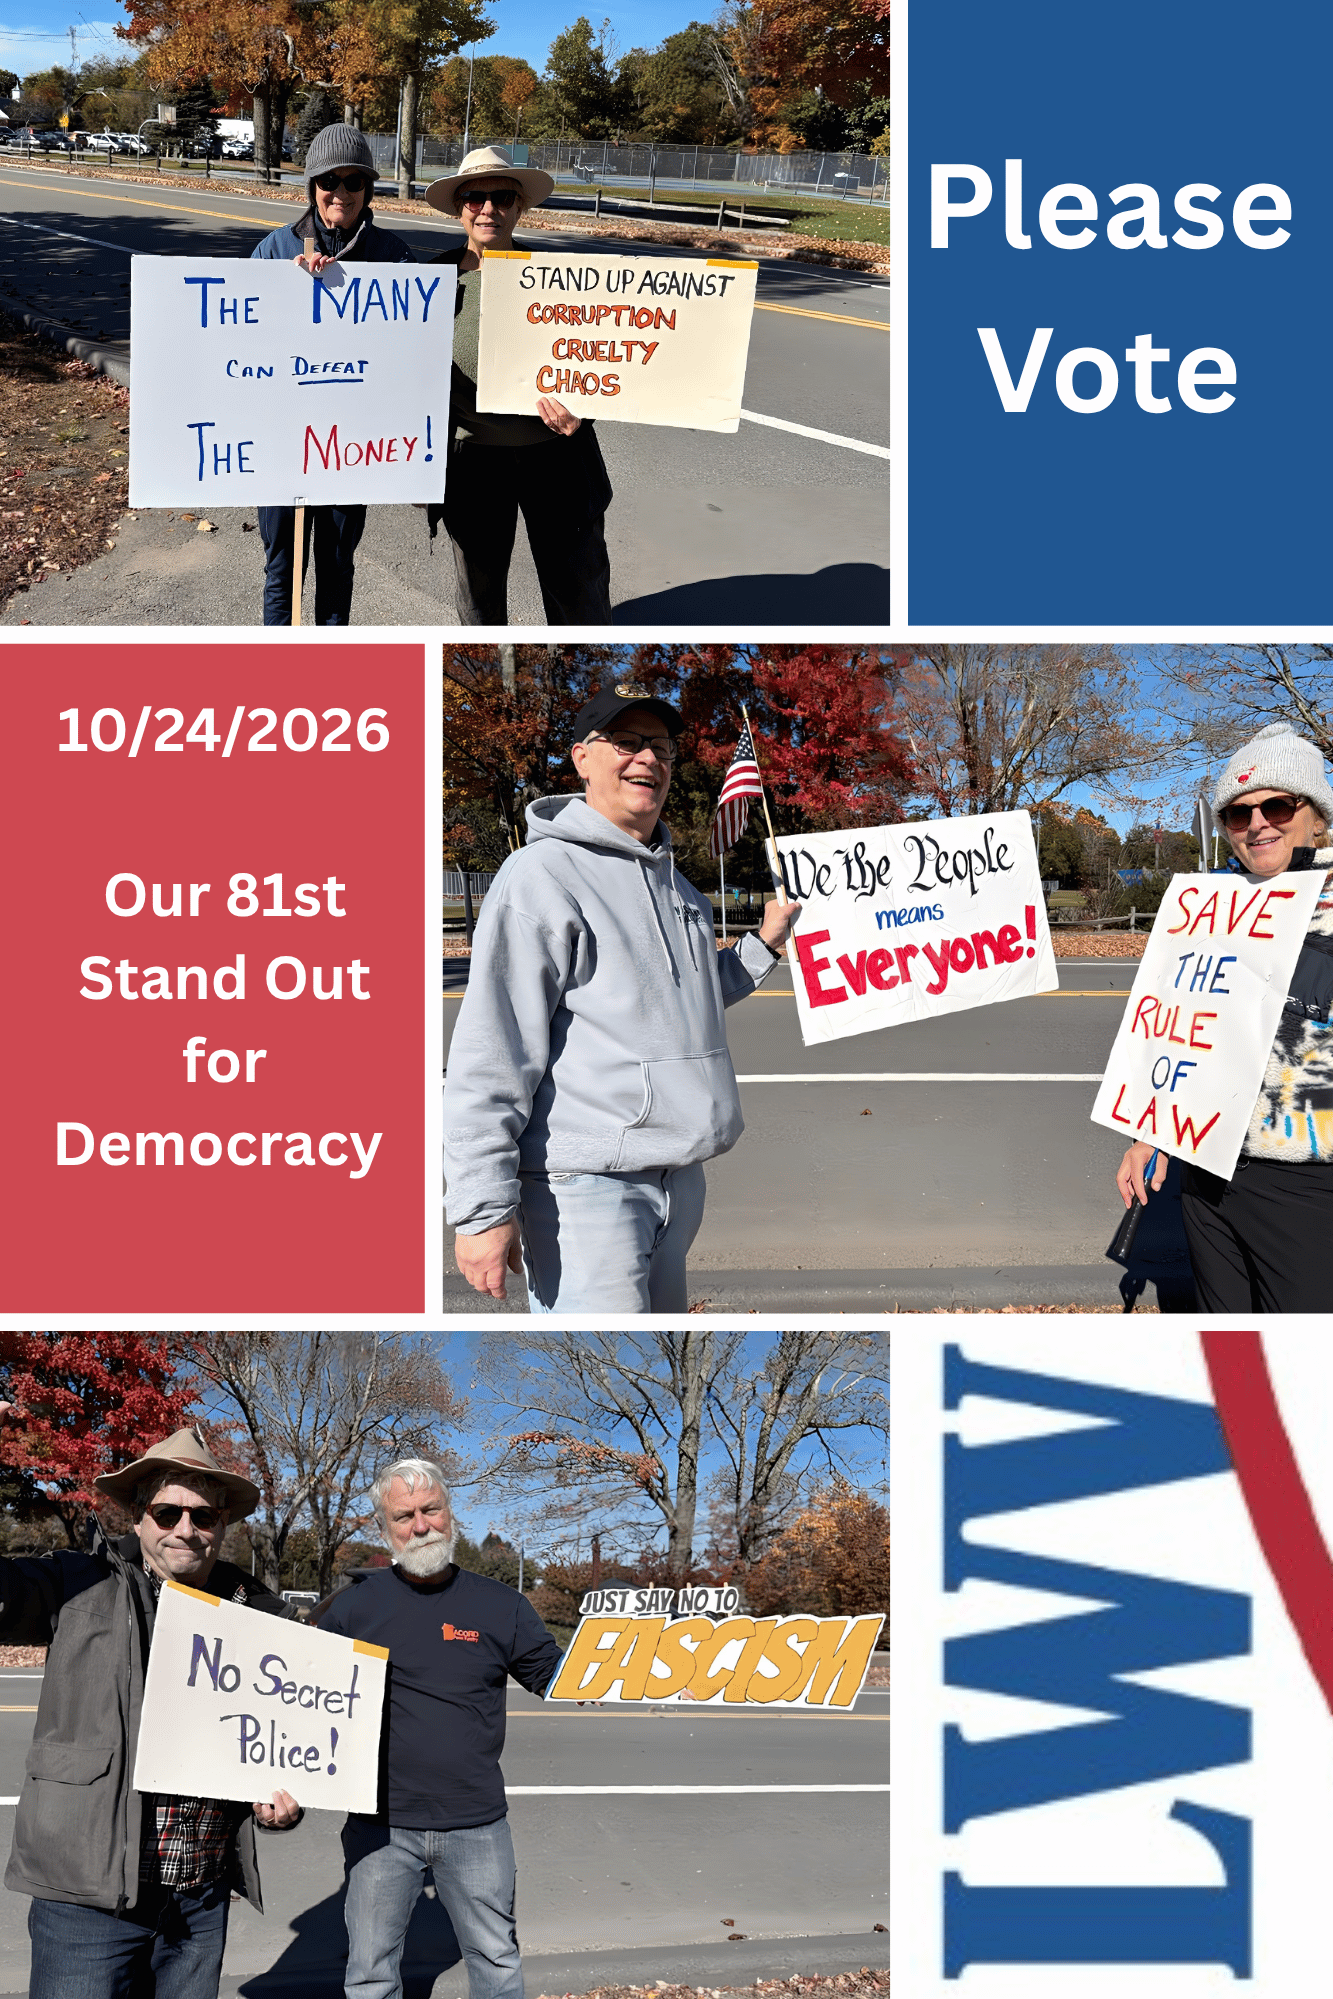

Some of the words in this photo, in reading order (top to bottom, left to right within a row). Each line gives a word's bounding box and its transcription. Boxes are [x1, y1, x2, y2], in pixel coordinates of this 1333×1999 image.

[184, 277, 260, 328] THE
[312, 277, 440, 325] MANY
[519, 266, 600, 292] STAND
[606, 269, 634, 294] UP
[637, 270, 735, 300] AGAINST
[527, 302, 677, 331] CORRUPTION
[290, 356, 369, 378] DEFEAT
[552, 338, 659, 365] CRUELTY
[536, 365, 621, 397] CHAOS
[186, 422, 255, 482] THE
[777, 847, 838, 902] We
[833, 841, 894, 903] the
[904, 827, 1015, 898] People
[875, 903, 945, 931] means
[1167, 887, 1297, 939] SAVE
[795, 904, 1037, 1009] Everyone!
[1174, 952, 1237, 995] THE
[1132, 995, 1218, 1050] RULE
[1151, 1055, 1198, 1092] OF
[1111, 1084, 1221, 1154] LAW
[582, 1590, 630, 1614] JUST
[634, 1588, 675, 1612] SAY
[680, 1588, 709, 1613] NO
[714, 1588, 738, 1612] TO
[187, 1633, 241, 1693] No
[253, 1653, 361, 1719] Secret
[551, 1617, 884, 1707] FASCISM
[219, 1714, 339, 1776] Police!
